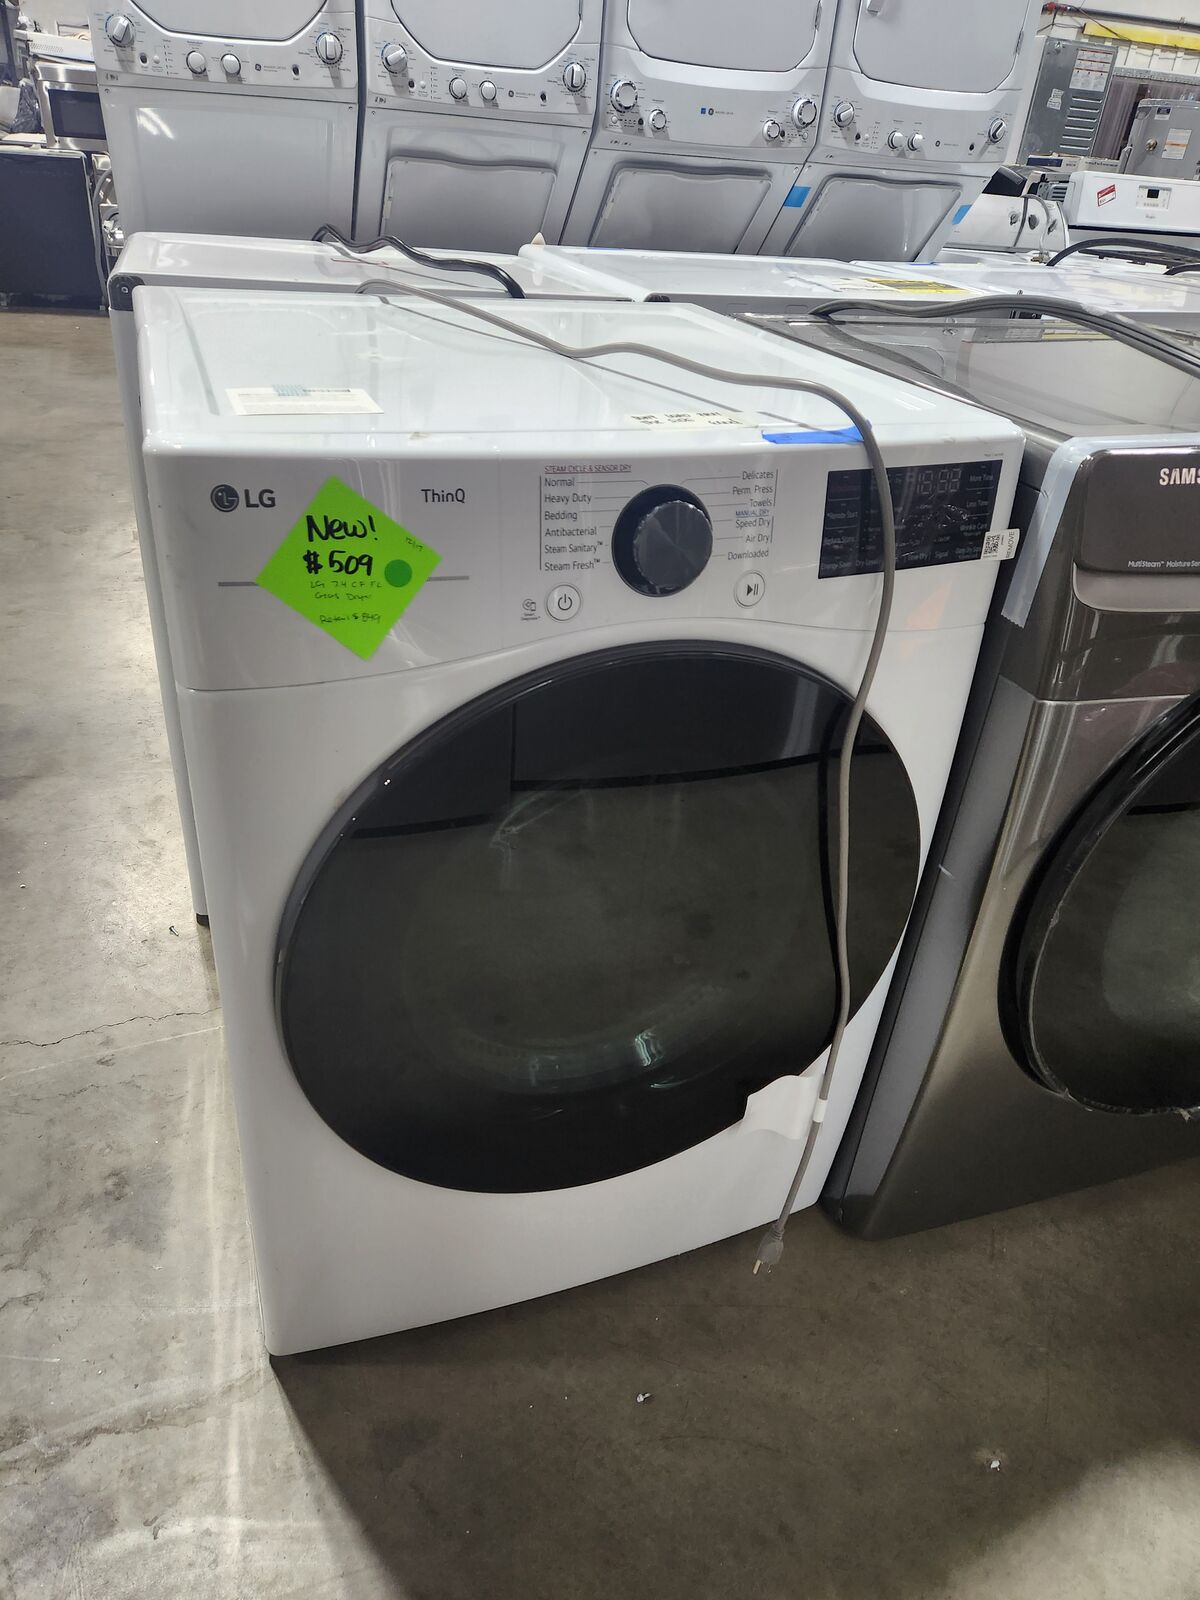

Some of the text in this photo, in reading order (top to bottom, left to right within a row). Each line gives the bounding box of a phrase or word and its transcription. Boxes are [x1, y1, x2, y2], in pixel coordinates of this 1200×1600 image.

[544, 465, 567, 473] STEAM
[594, 464, 619, 472] SENSOR
[619, 463, 632, 471] DRY
[742, 471, 774, 480] Delicates
[544, 477, 575, 487] Normal
[754, 484, 774, 494] Press
[244, 488, 276, 508] LG
[421, 488, 465, 503] ThinQ
[544, 492, 592, 505] Heavy Duty
[750, 498, 772, 508] Towels
[544, 510, 578, 522] Bedding
[306, 514, 378, 542] New!
[736, 517, 770, 530] Speed Dry
[544, 526, 597, 537] Antibacterial
[745, 533, 769, 543] Air Dry
[544, 544, 568, 554] Steam
[727, 549, 769, 560] Downloaded
[544, 562, 571, 572] Steam
[1166, 560, 1191, 568] Moisture
